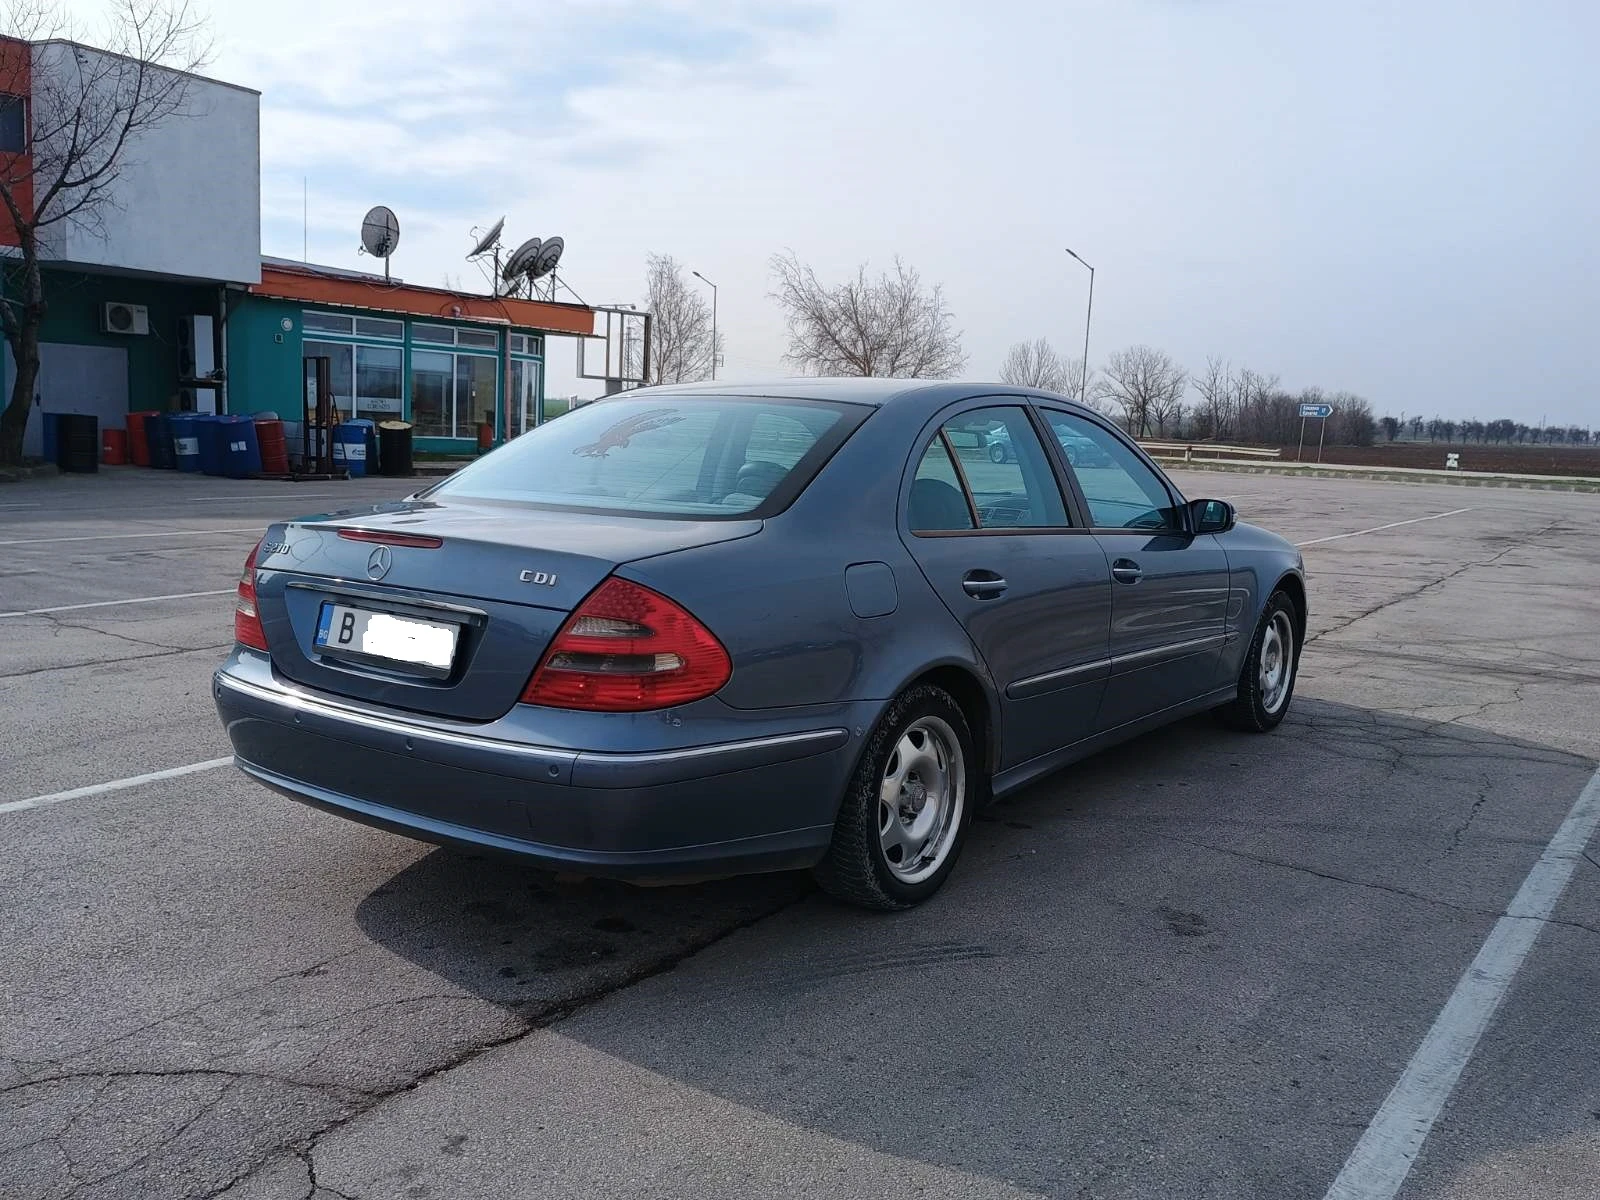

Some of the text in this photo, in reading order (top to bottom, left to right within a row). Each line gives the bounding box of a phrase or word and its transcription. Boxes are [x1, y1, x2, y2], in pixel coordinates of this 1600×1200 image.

[519, 569, 557, 586] CDI
[318, 629, 329, 640] BG
[338, 612, 356, 644] B
